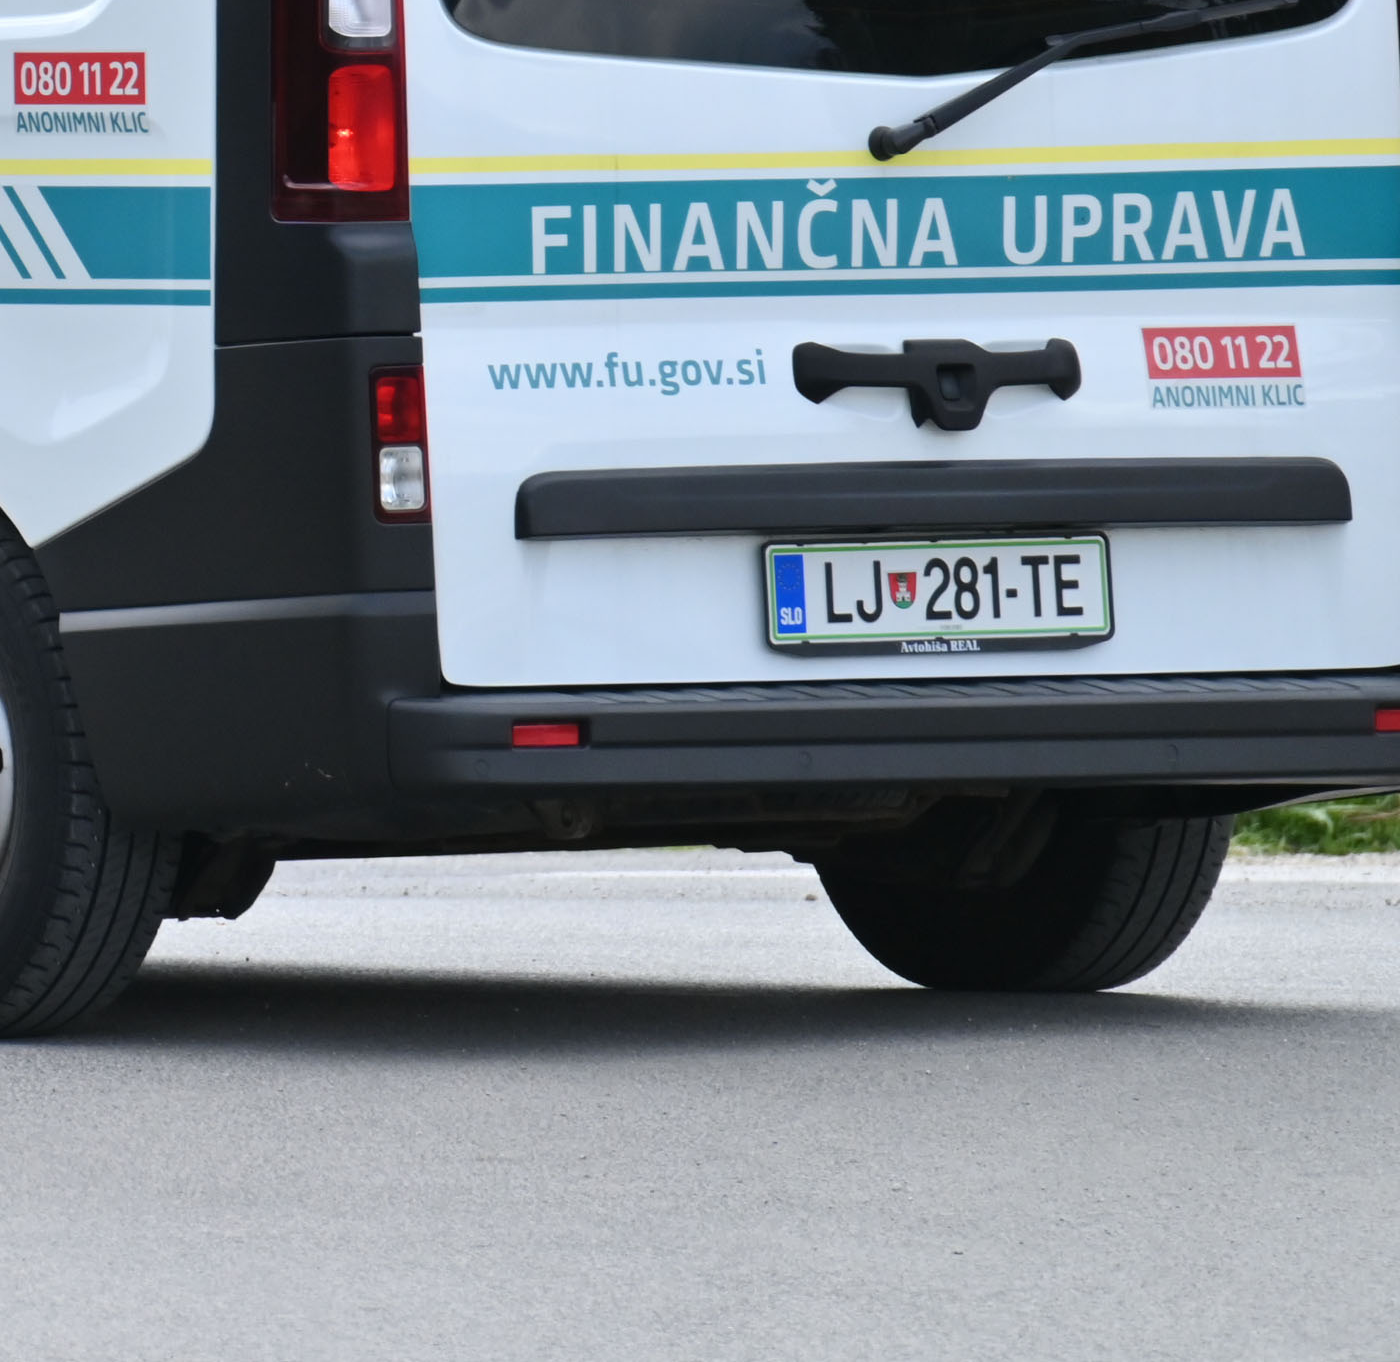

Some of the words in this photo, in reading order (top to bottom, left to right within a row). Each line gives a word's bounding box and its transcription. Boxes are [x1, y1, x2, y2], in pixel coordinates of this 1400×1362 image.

[20, 61, 72, 96] 080
[79, 62, 102, 96] 11
[109, 61, 139, 96] 22
[16, 111, 107, 134] ANONIMNI
[110, 111, 150, 133] KLIC
[531, 178, 959, 275] FINANČNA
[1002, 188, 1306, 266] UPRAVA
[1152, 336, 1214, 370] 080
[1220, 336, 1250, 369] 11
[1255, 335, 1293, 369] 22
[487, 348, 767, 396] www.fu.gov.si
[1152, 385, 1256, 408] ANONIMNI
[1262, 383, 1306, 406] KLIC
[824, 559, 884, 624] LJ
[923, 554, 1084, 621] 281-TE
[779, 606, 804, 626] SLO
[901, 640, 948, 654] Avtohiša
[949, 639, 981, 653] REAL
